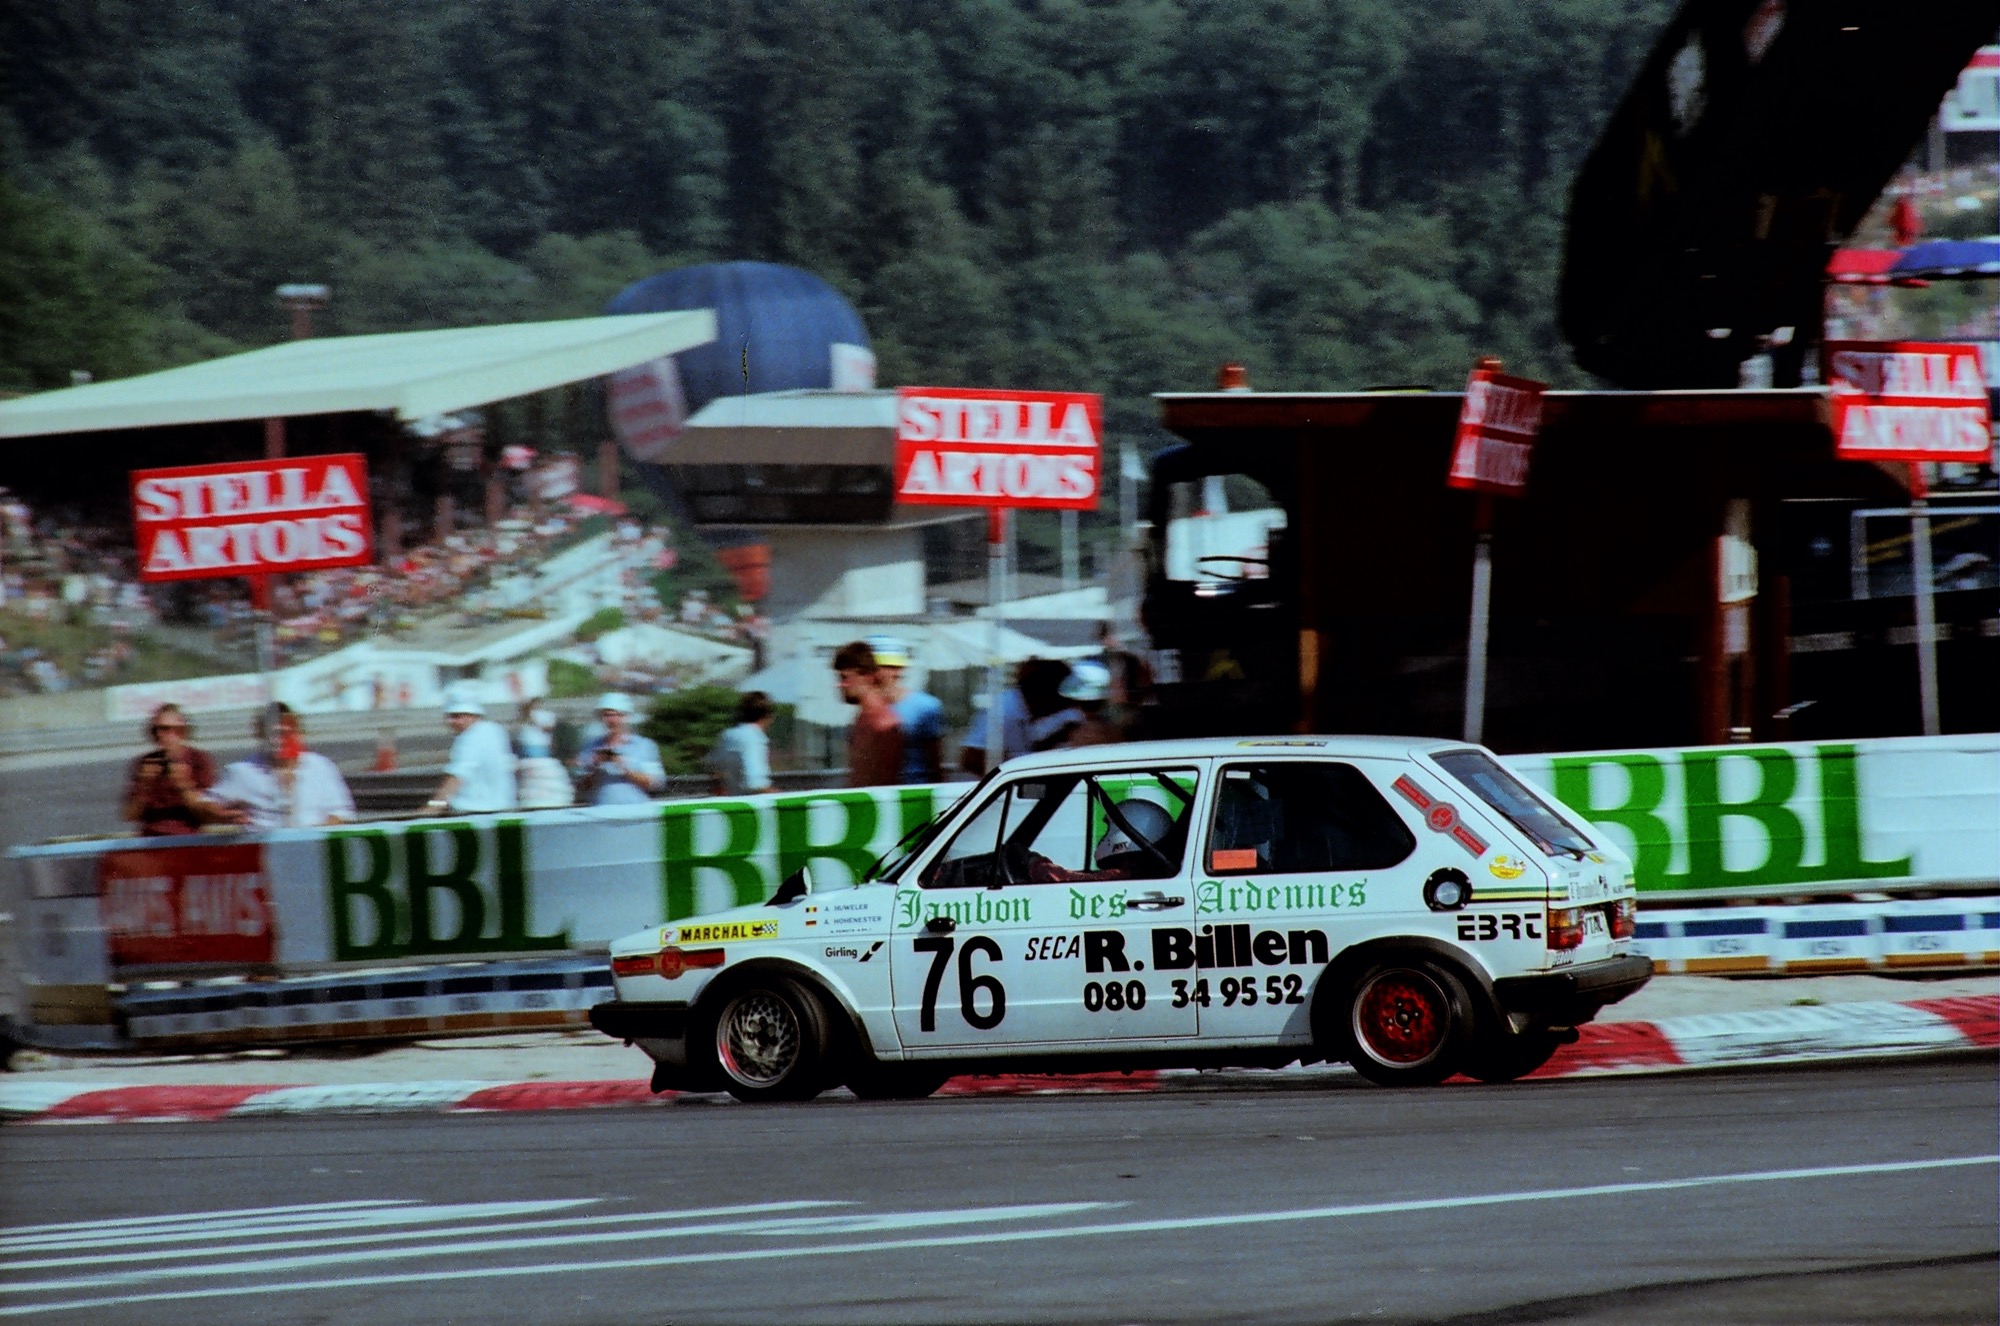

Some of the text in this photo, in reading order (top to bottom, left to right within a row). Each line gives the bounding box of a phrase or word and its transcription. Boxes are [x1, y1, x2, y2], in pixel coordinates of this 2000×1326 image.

[900, 397, 1098, 447] STELLA
[135, 465, 366, 521] STELLA
[900, 450, 1095, 500] ARTOIS
[144, 514, 365, 572] ARTOIS
[1552, 744, 1914, 892] BBL
[326, 819, 573, 961] BBL
[895, 878, 1368, 928] Jambon des Ardennes
[681, 925, 748, 941] MARCHAL
[825, 947, 858, 959] Girling
[1025, 935, 1080, 960] SECA
[913, 935, 1006, 1032] 76
[1084, 980, 1146, 1012] 080
